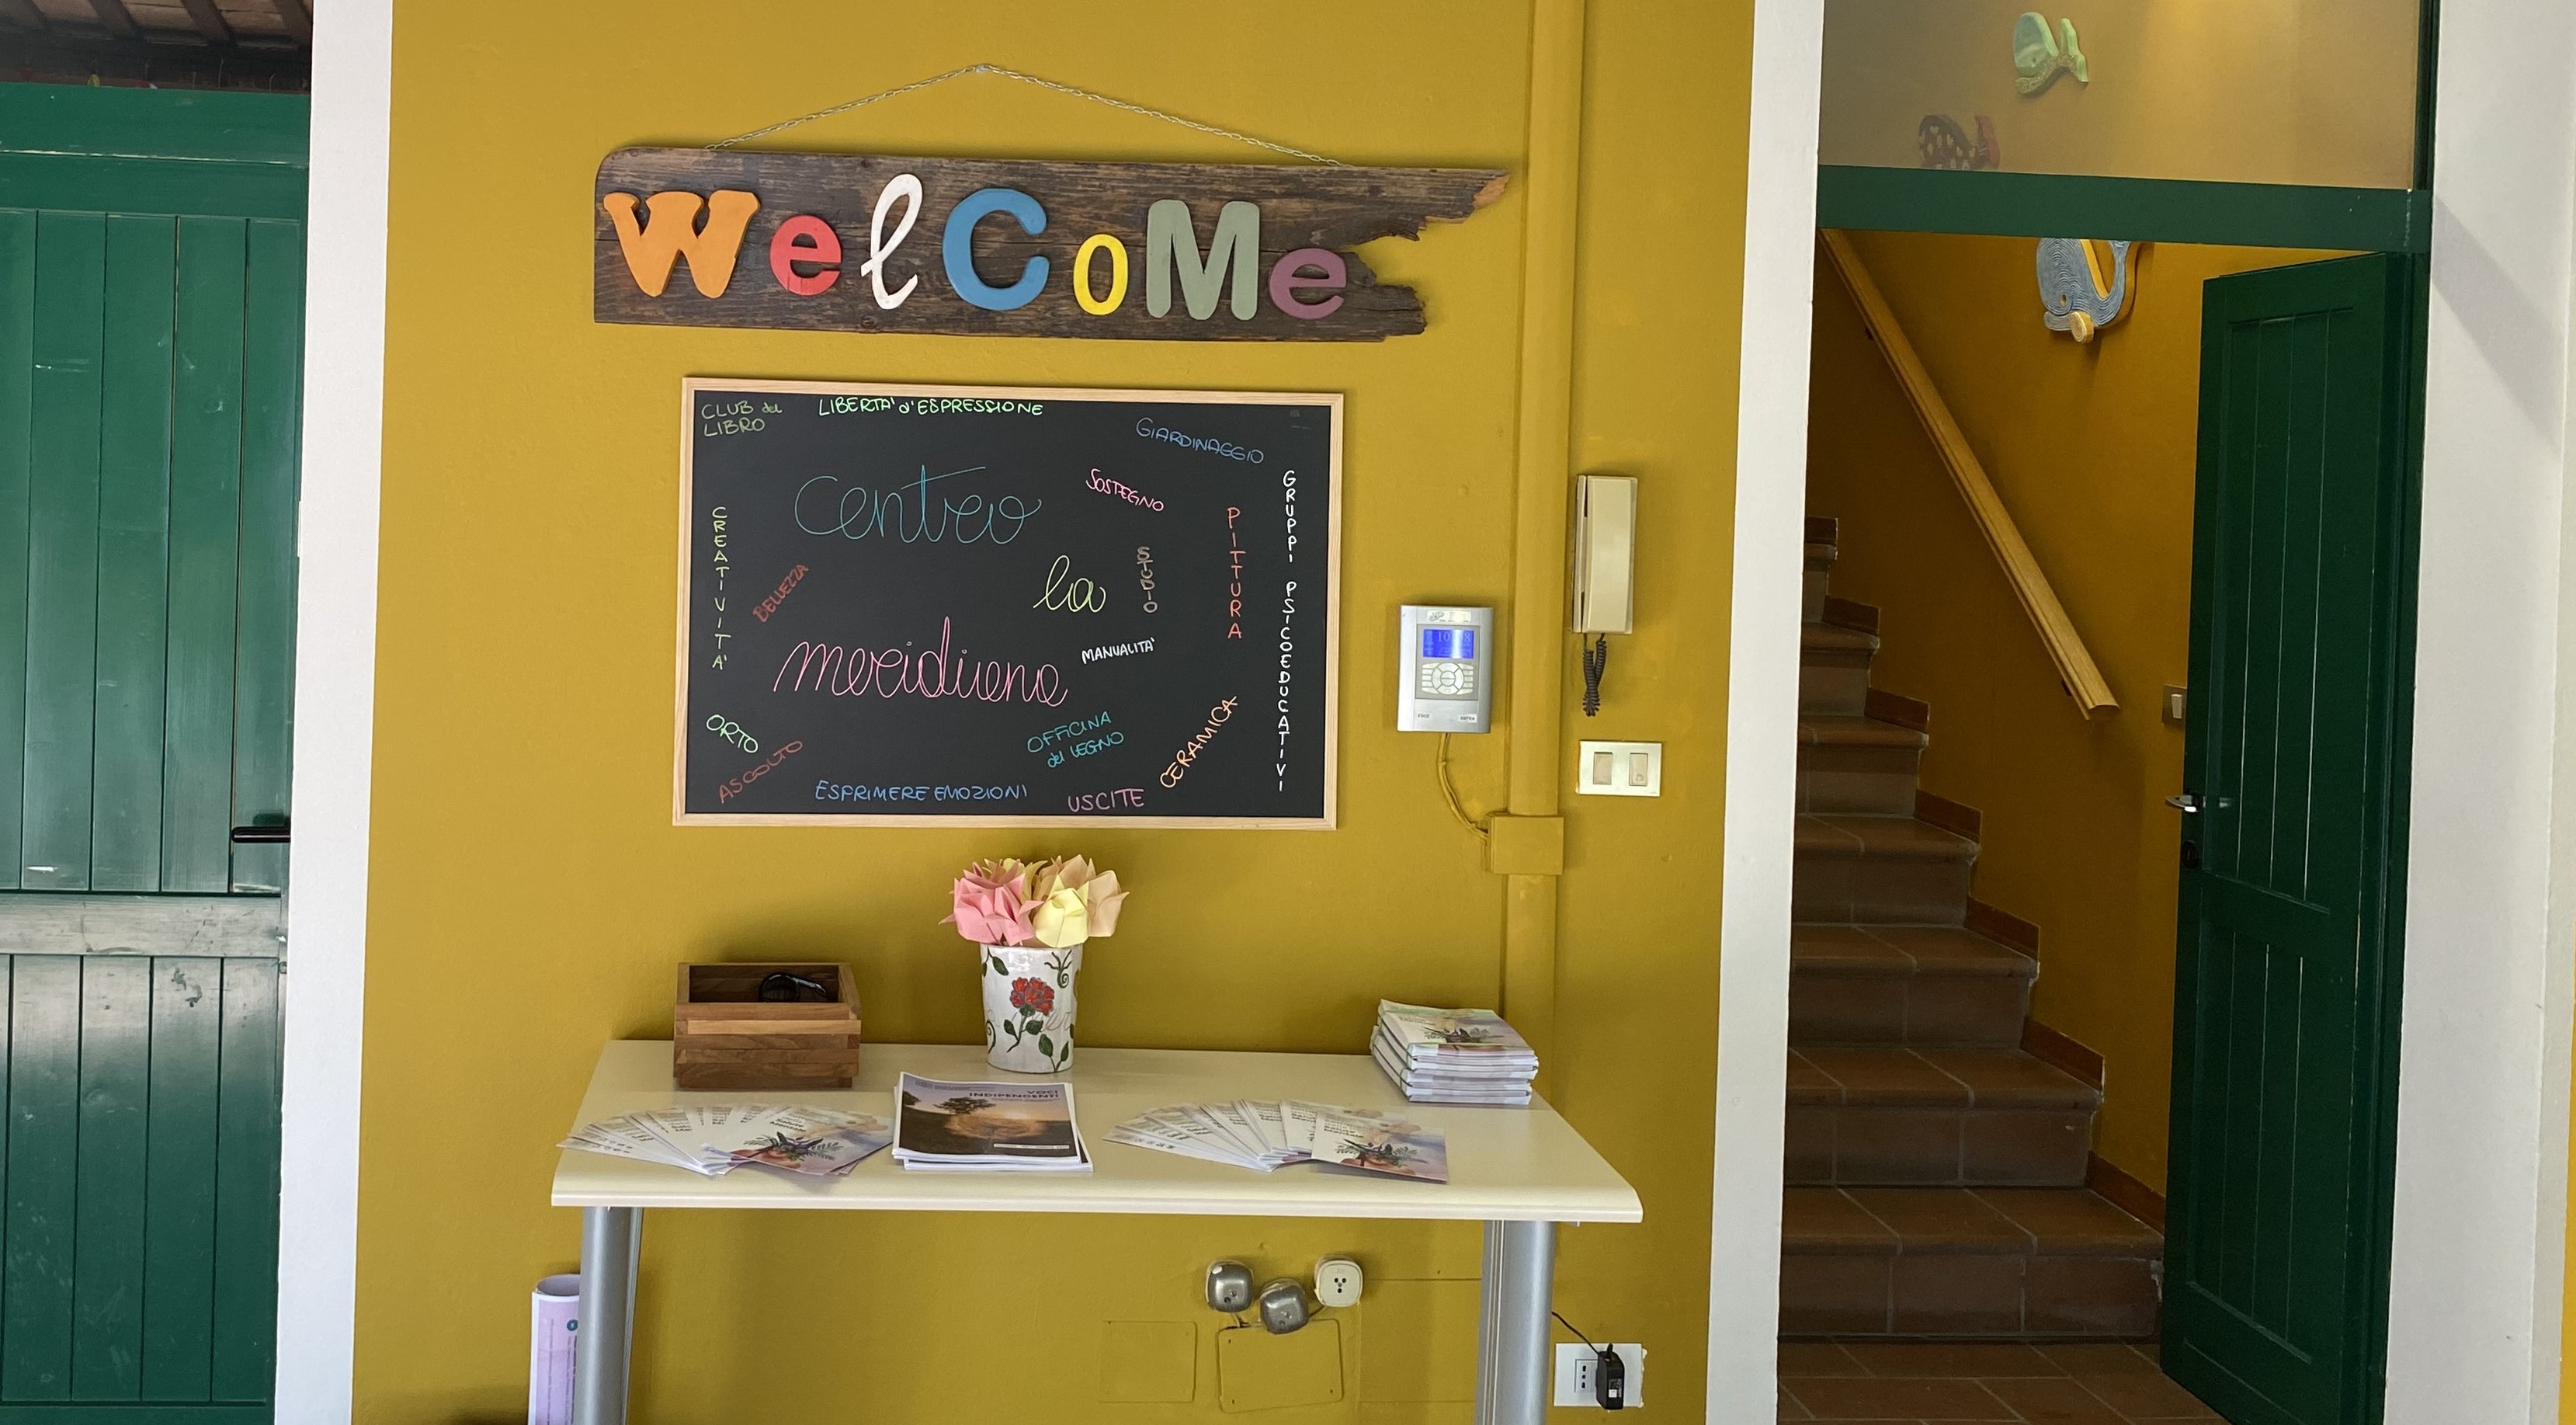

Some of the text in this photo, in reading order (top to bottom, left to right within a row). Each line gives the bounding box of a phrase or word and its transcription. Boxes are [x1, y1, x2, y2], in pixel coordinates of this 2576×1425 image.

[701, 400, 783, 420] CLUB del
[703, 418, 766, 437] LIBRO
[1136, 417, 1264, 464] GIARDINAGGIO
[1085, 467, 1165, 512] SOSTEGNO
[752, 565, 809, 623] BELLEZZA
[1033, 554, 1106, 614] la
[1136, 546, 1158, 613] STUDIO
[1227, 506, 1247, 638] PITTURA
[1276, 469, 1297, 792] GRUPPI PSICOEDUCATIVI
[706, 714, 759, 753] ORTO
[1027, 711, 1112, 753] OFFICINA
[1047, 731, 1124, 768] del LEGNO
[1159, 695, 1238, 788] CERAMICA
[719, 740, 803, 804] ASCOLTO
[815, 779, 1028, 802] ESPRIMERE EMOZIONI
[1067, 787, 1145, 813] USCITE
